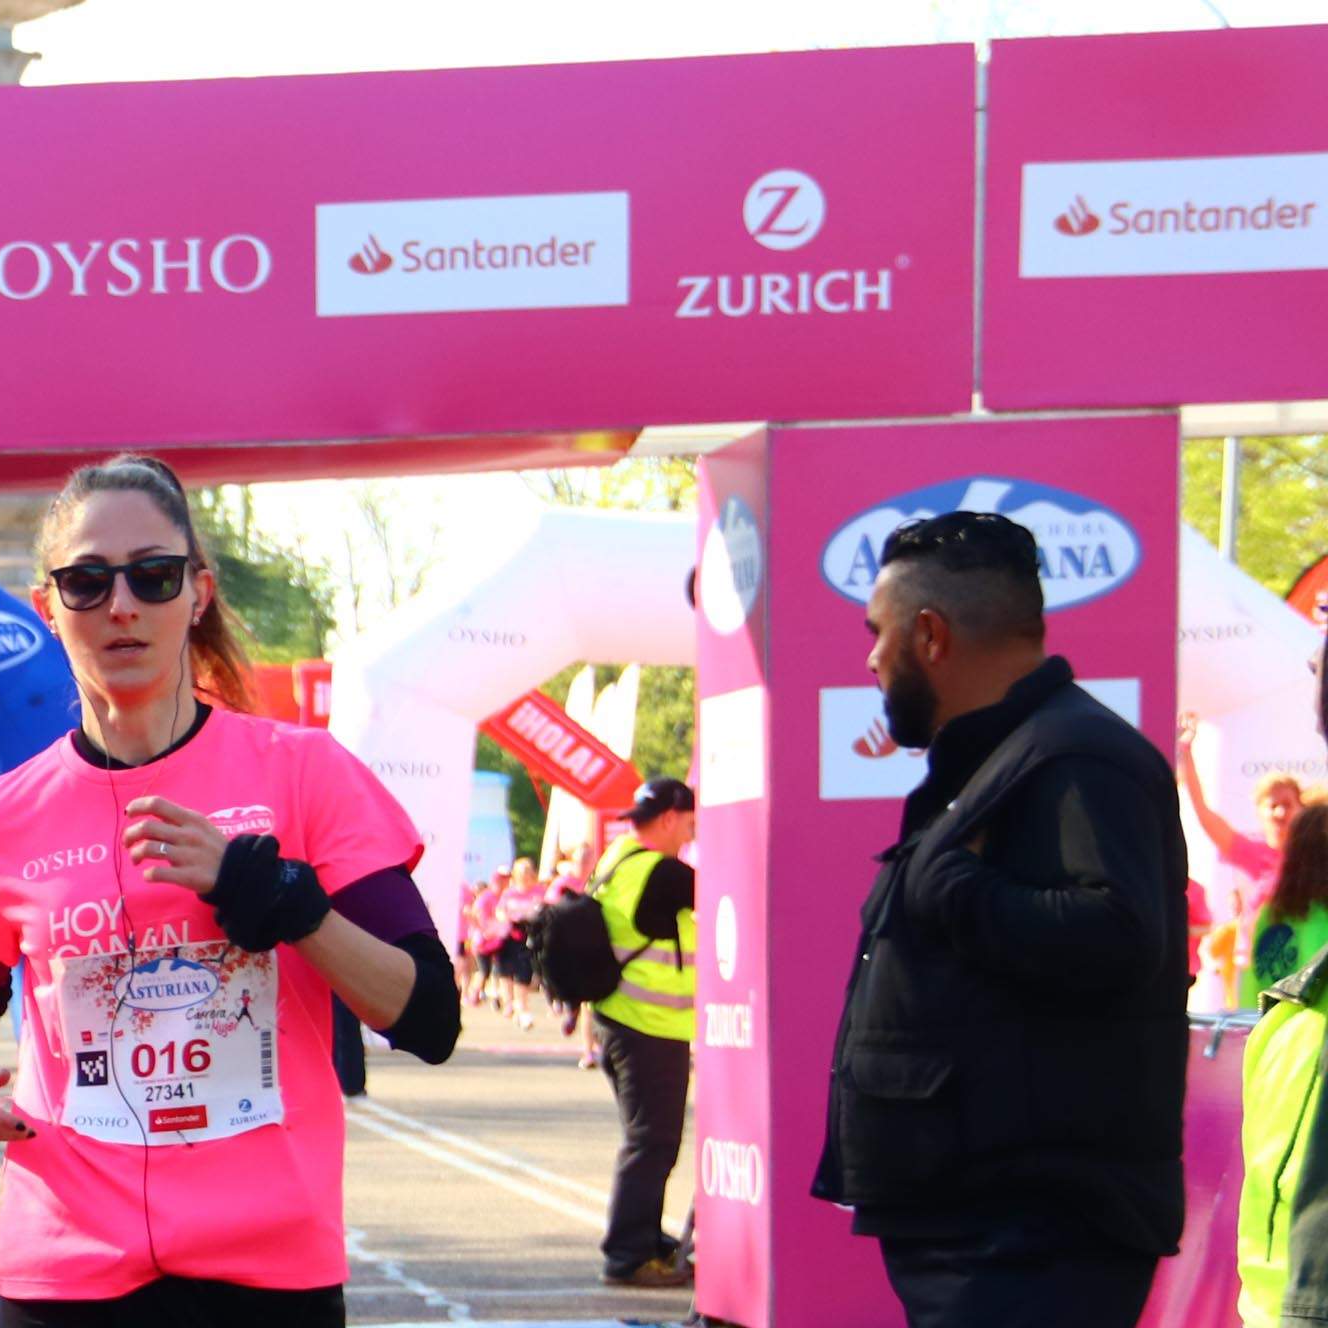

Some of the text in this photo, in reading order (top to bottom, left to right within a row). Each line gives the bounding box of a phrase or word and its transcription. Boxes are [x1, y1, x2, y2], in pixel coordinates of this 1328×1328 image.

[1107, 196, 1317, 236] Santander
[401, 233, 597, 274] Santander
[675, 269, 893, 319] ZURICH
[447, 627, 527, 648] OYSHO
[22, 843, 108, 881] OYSHO
[47, 897, 126, 945] HOY
[124, 979, 211, 1000] ASTURIANA
[130, 1038, 212, 1079] 016
[145, 1082, 195, 1103] 27341
[73, 1114, 129, 1129] OYSHO
[701, 1136, 764, 1206] OYSHO
